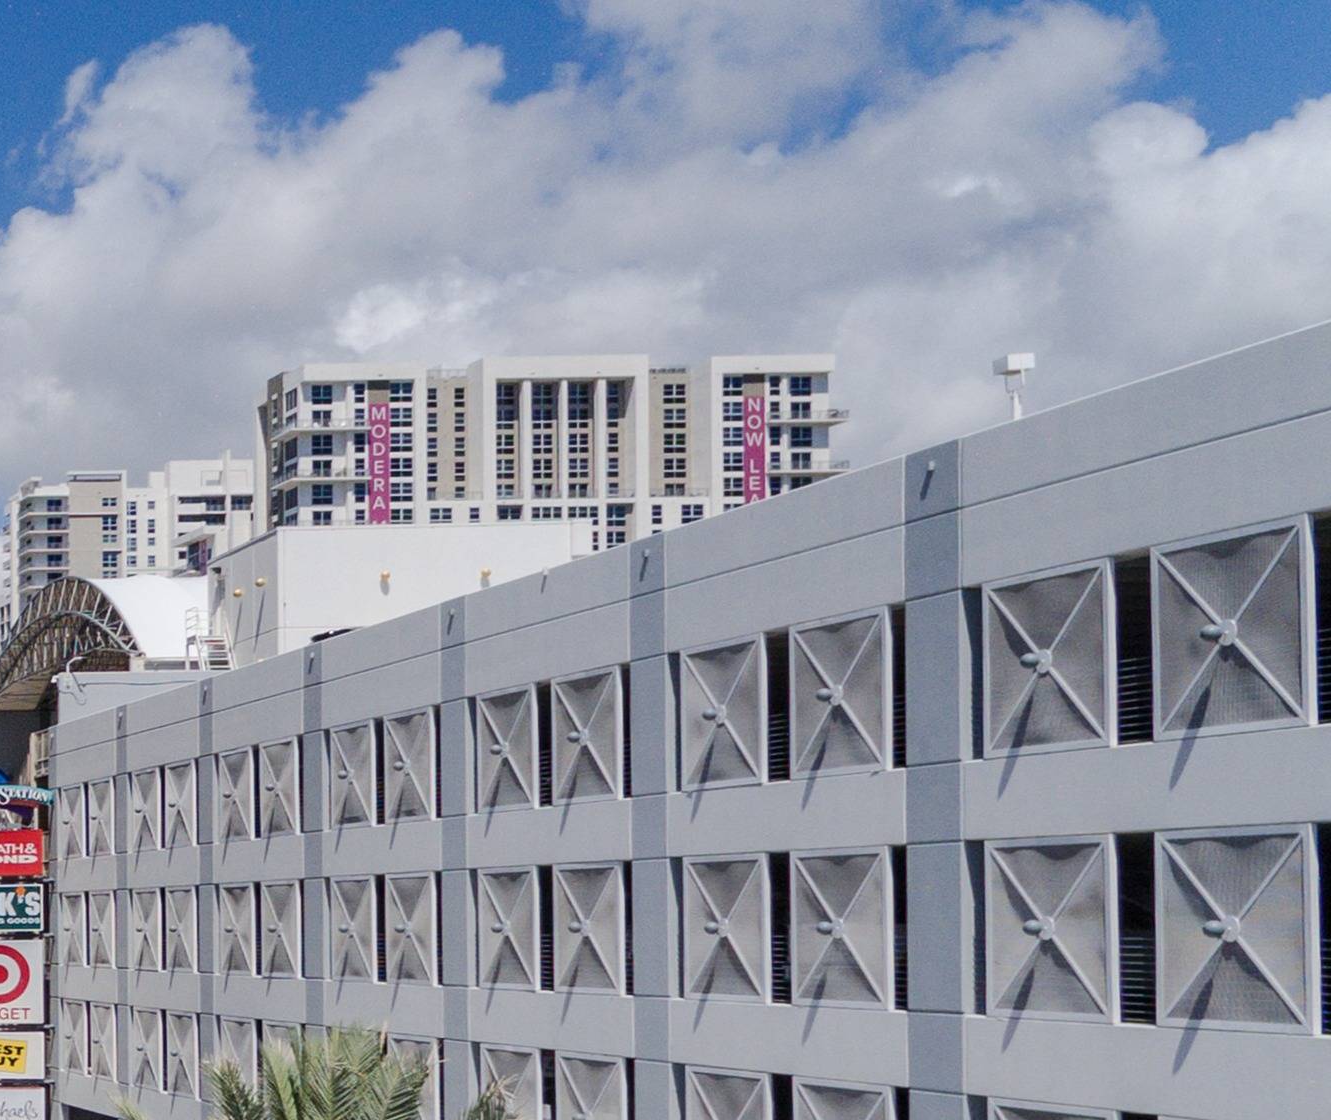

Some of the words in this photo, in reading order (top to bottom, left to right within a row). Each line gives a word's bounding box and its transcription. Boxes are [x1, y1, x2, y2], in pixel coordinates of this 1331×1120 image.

[746, 398, 763, 447] NOW
[371, 406, 387, 510] MODERA
[24, 842, 38, 855] &
[6, 917, 41, 925] GOODS
